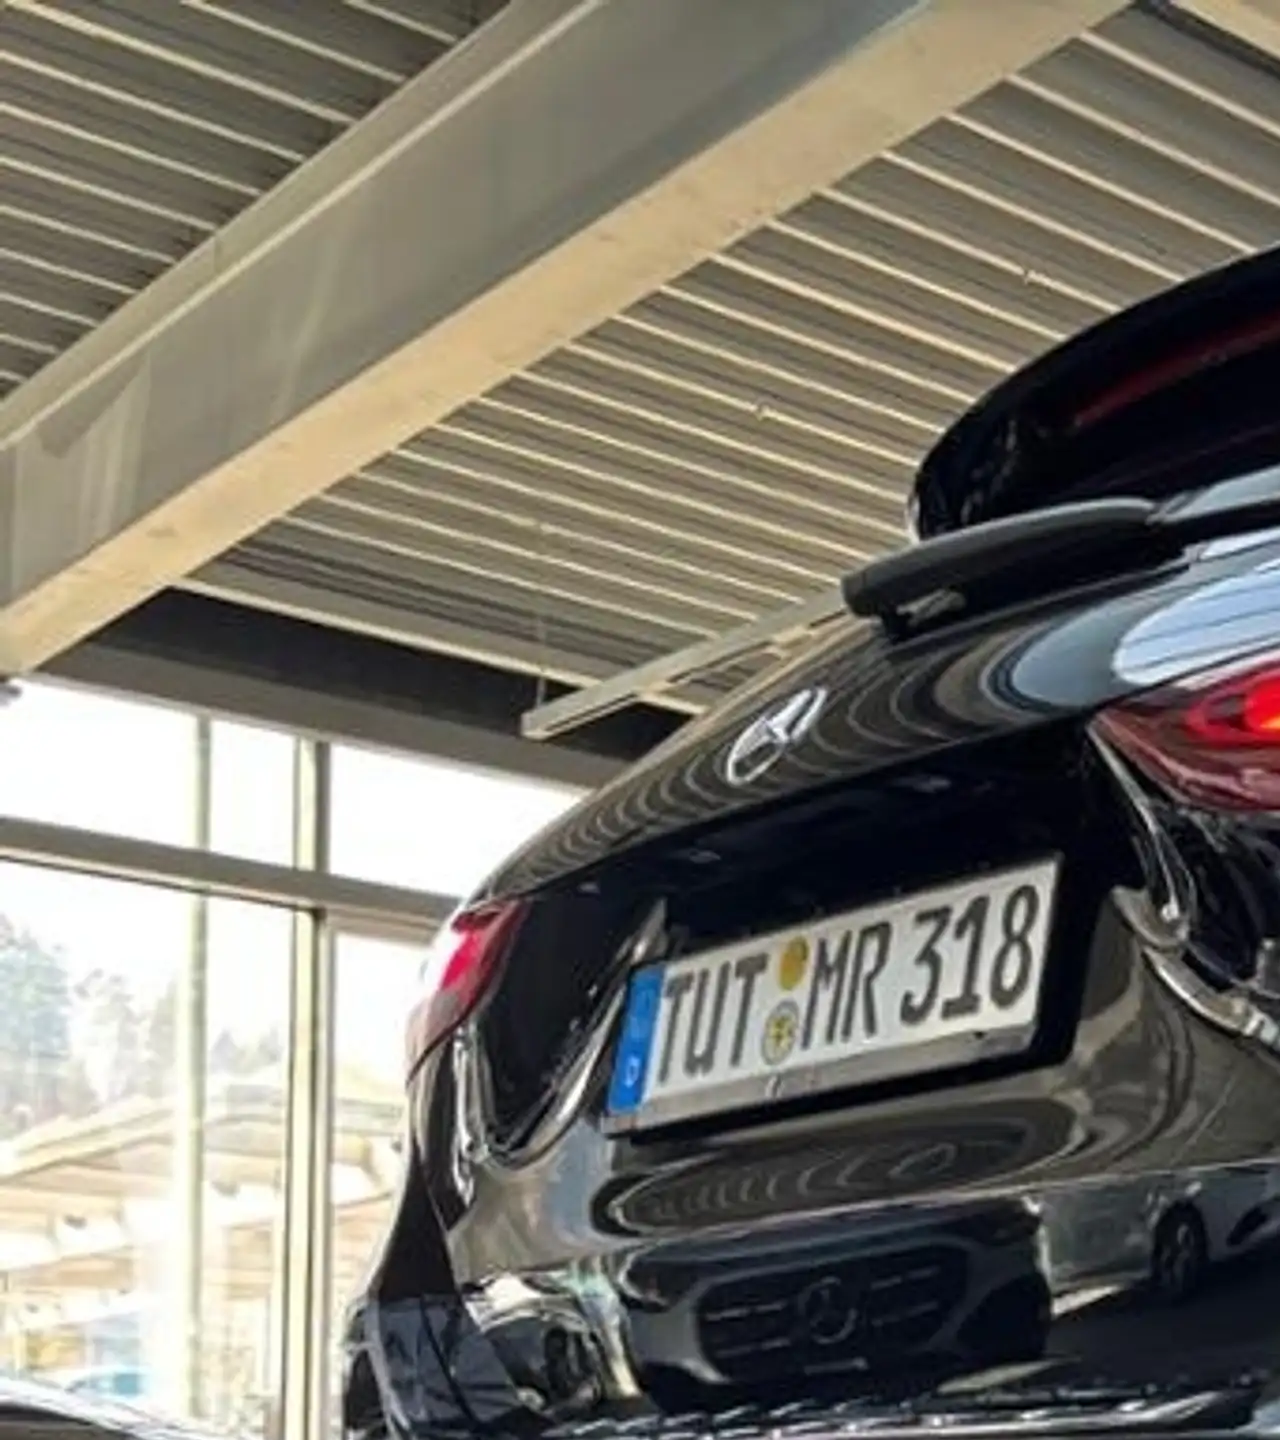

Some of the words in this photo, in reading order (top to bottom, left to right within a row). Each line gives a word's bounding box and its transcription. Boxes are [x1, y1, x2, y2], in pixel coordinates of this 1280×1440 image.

[659, 952, 769, 1084] TUT
[802, 920, 894, 1050] MR
[900, 884, 1041, 1028] 318
